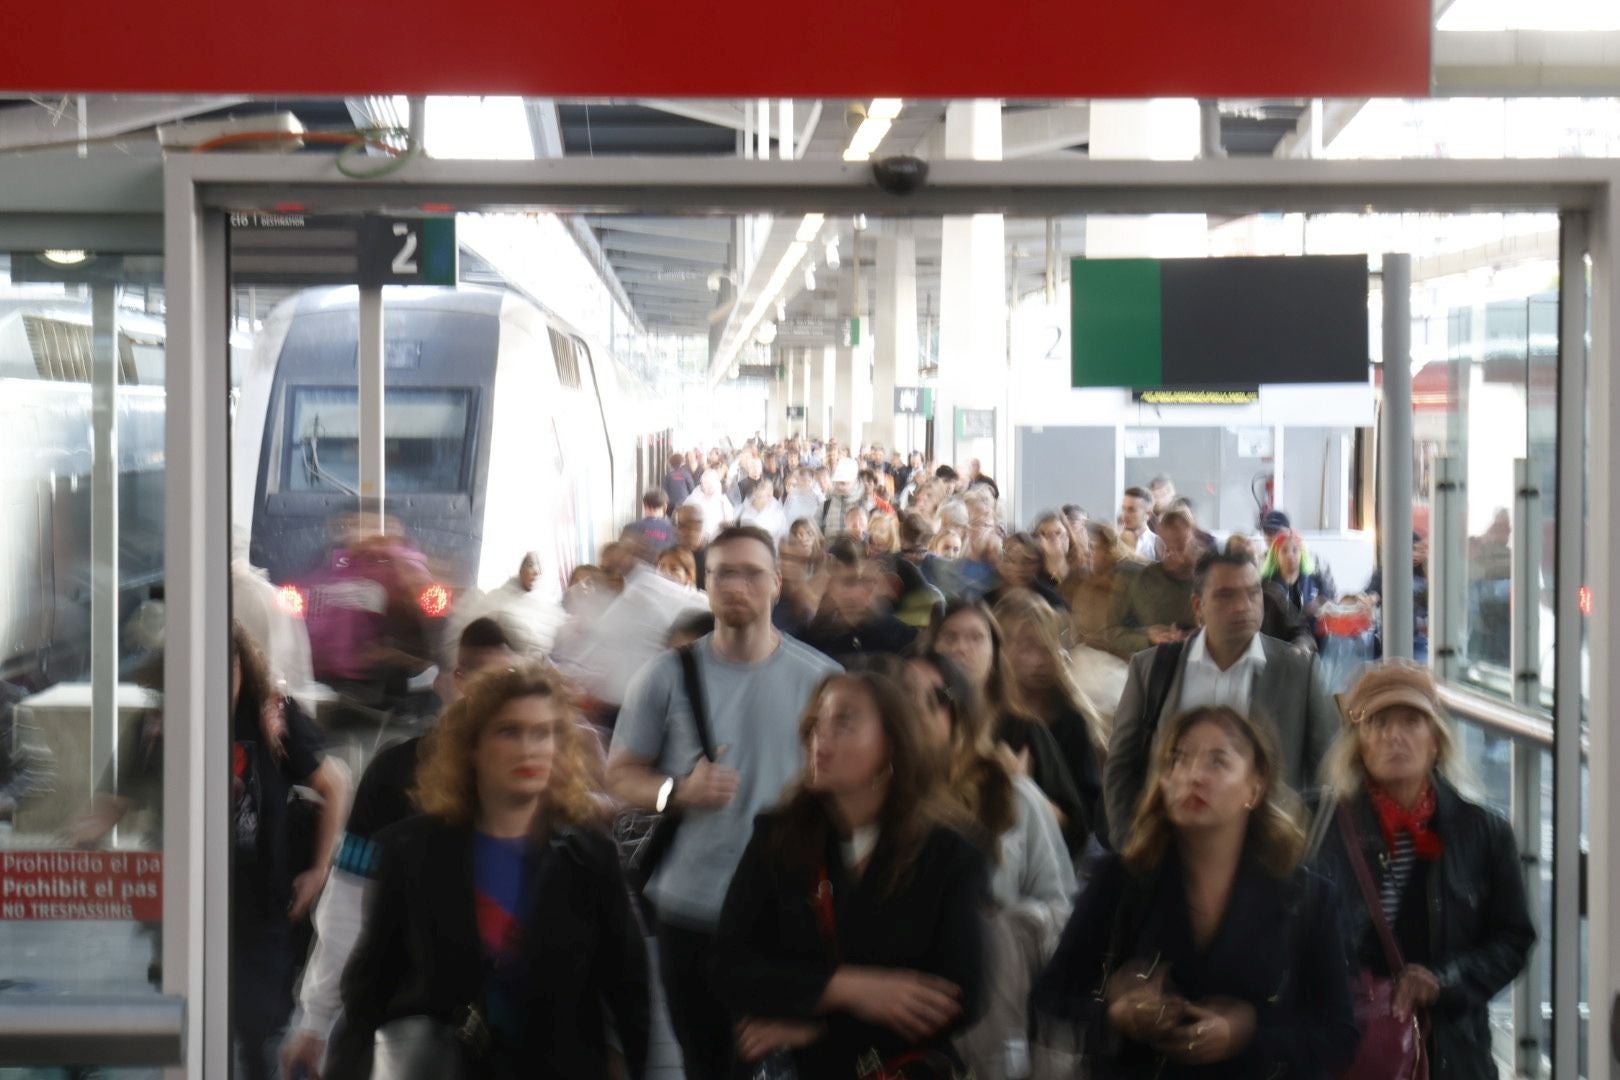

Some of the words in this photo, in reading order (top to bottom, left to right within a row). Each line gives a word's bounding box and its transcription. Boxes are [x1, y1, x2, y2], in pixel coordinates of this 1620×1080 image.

[391, 222, 418, 274] 2
[3, 853, 103, 873] Prohibido
[111, 853, 128, 873] el
[3, 876, 88, 898] Prohibit
[95, 876, 114, 898] el
[122, 880, 158, 901] pas
[3, 901, 25, 919] NO
[31, 901, 134, 919] TRESPASSING
